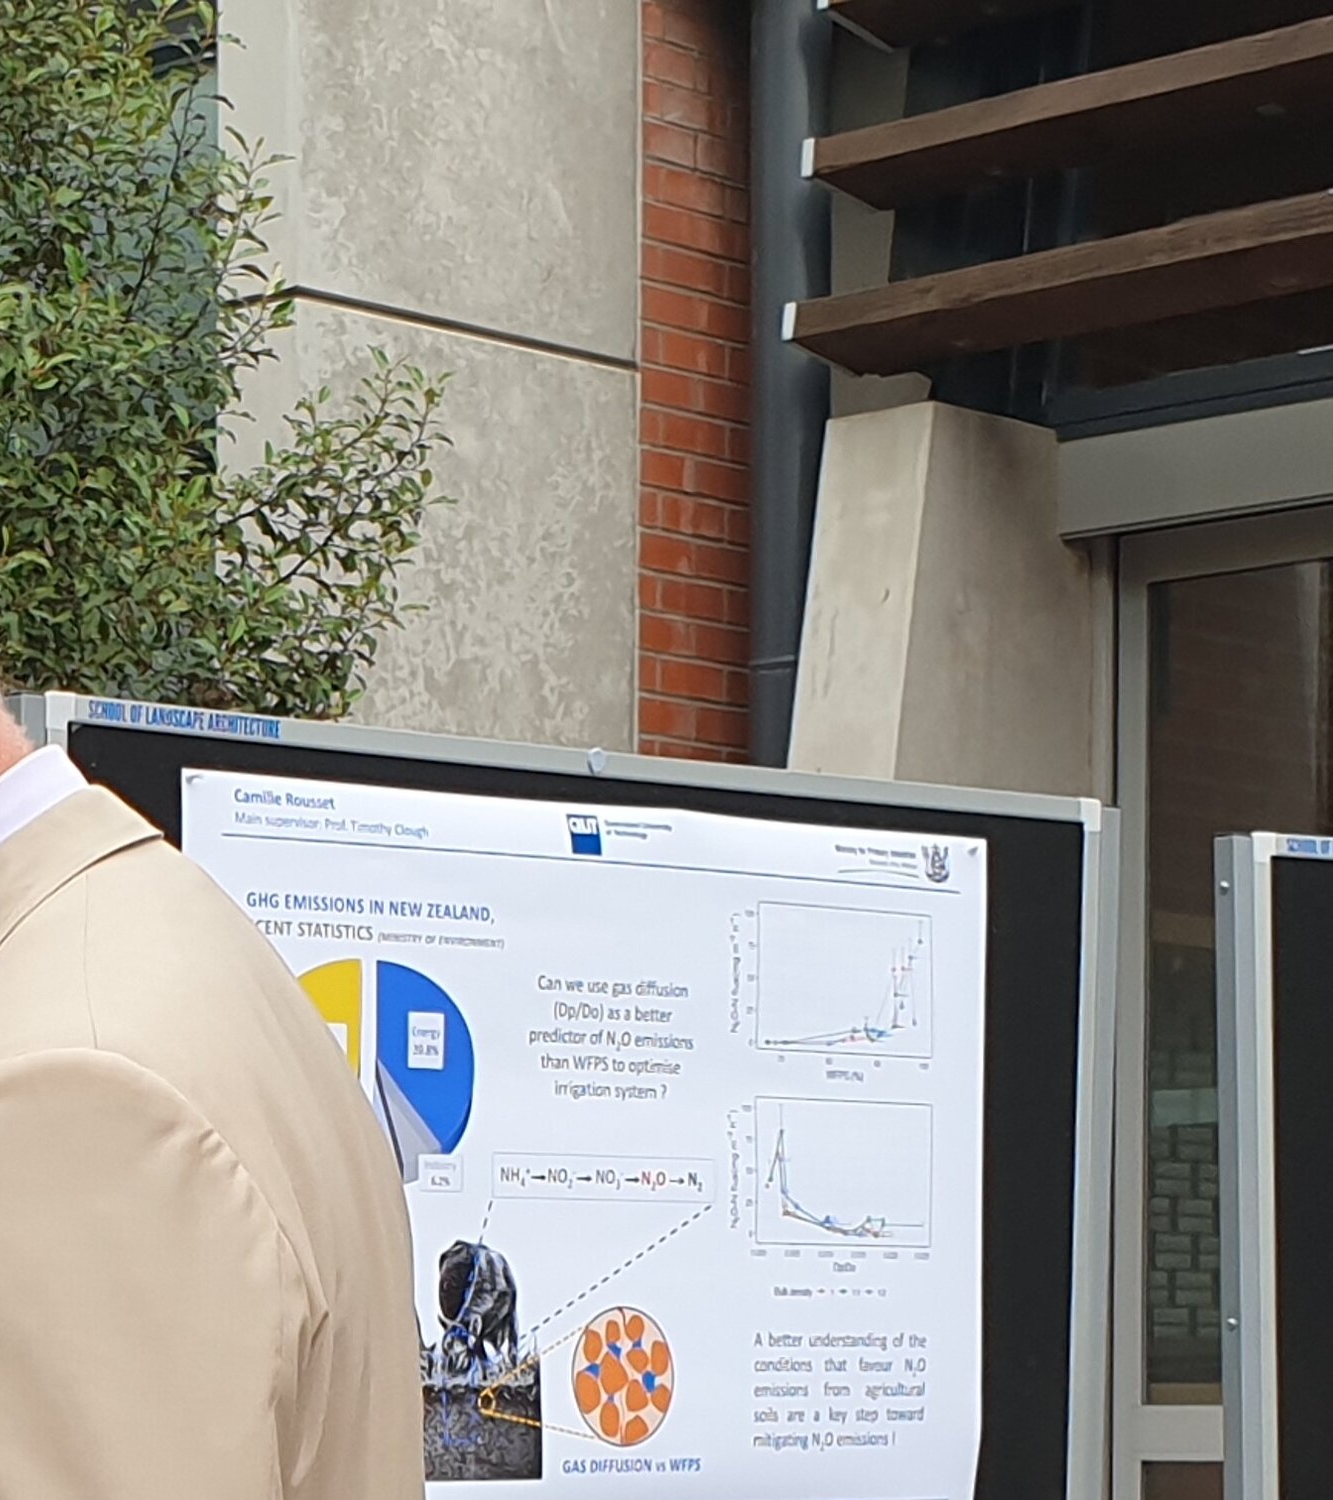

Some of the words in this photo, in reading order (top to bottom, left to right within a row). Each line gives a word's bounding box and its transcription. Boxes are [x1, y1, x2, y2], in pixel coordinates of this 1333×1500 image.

[89, 700, 126, 722] SCHOOL
[130, 705, 143, 723] OF
[146, 707, 204, 730] LANDSCAPE
[208, 714, 280, 739] ARCHITECTURE
[234, 789, 282, 805] Camille
[286, 793, 336, 810] Rousset
[235, 812, 262, 824] Main
[351, 820, 391, 837] Timothy
[246, 892, 280, 909] GHG
[285, 894, 364, 914] EMISSIONS
[370, 900, 384, 914] IN
[389, 901, 422, 917] NEW
[426, 903, 495, 925] ZEALAND,
[298, 922, 373, 941] STATISTICS
[538, 975, 561, 991] Can
[565, 980, 583, 991] we
[587, 981, 608, 994] use
[612, 983, 631, 997] gas
[635, 981, 688, 998] diffusion
[607, 1008, 620, 1020] as
[624, 1010, 631, 1021] a
[635, 1006, 673, 1022] better
[529, 1028, 586, 1045] predictor
[590, 1029, 604, 1044] of
[634, 1033, 694, 1050] emissions
[541, 1054, 569, 1069] than
[573, 1055, 609, 1072] WFPS
[612, 1058, 625, 1072] to
[628, 1059, 681, 1076] optimise
[555, 1080, 611, 1099] irrigation
[615, 1084, 657, 1101] system
[754, 1333, 763, 1347] A
[769, 1332, 803, 1347] better
[893, 1333, 904, 1348] of
[909, 1334, 927, 1348] the
[755, 1357, 812, 1372] conditions
[825, 1358, 847, 1372] that
[859, 1357, 893, 1372] favour
[754, 1383, 808, 1397] emissions
[824, 1382, 850, 1397] from
[865, 1382, 926, 1400] agricultural
[754, 1407, 778, 1422] soils
[787, 1410, 804, 1422] are
[829, 1406, 847, 1424] key
[856, 1408, 878, 1423] step
[886, 1406, 924, 1421] toward
[837, 1433, 888, 1447] emissions
[562, 1459, 586, 1473] GAS
[590, 1458, 652, 1473] DIFFUSION
[655, 1461, 666, 1473] vs
[670, 1458, 702, 1472] WFPS
